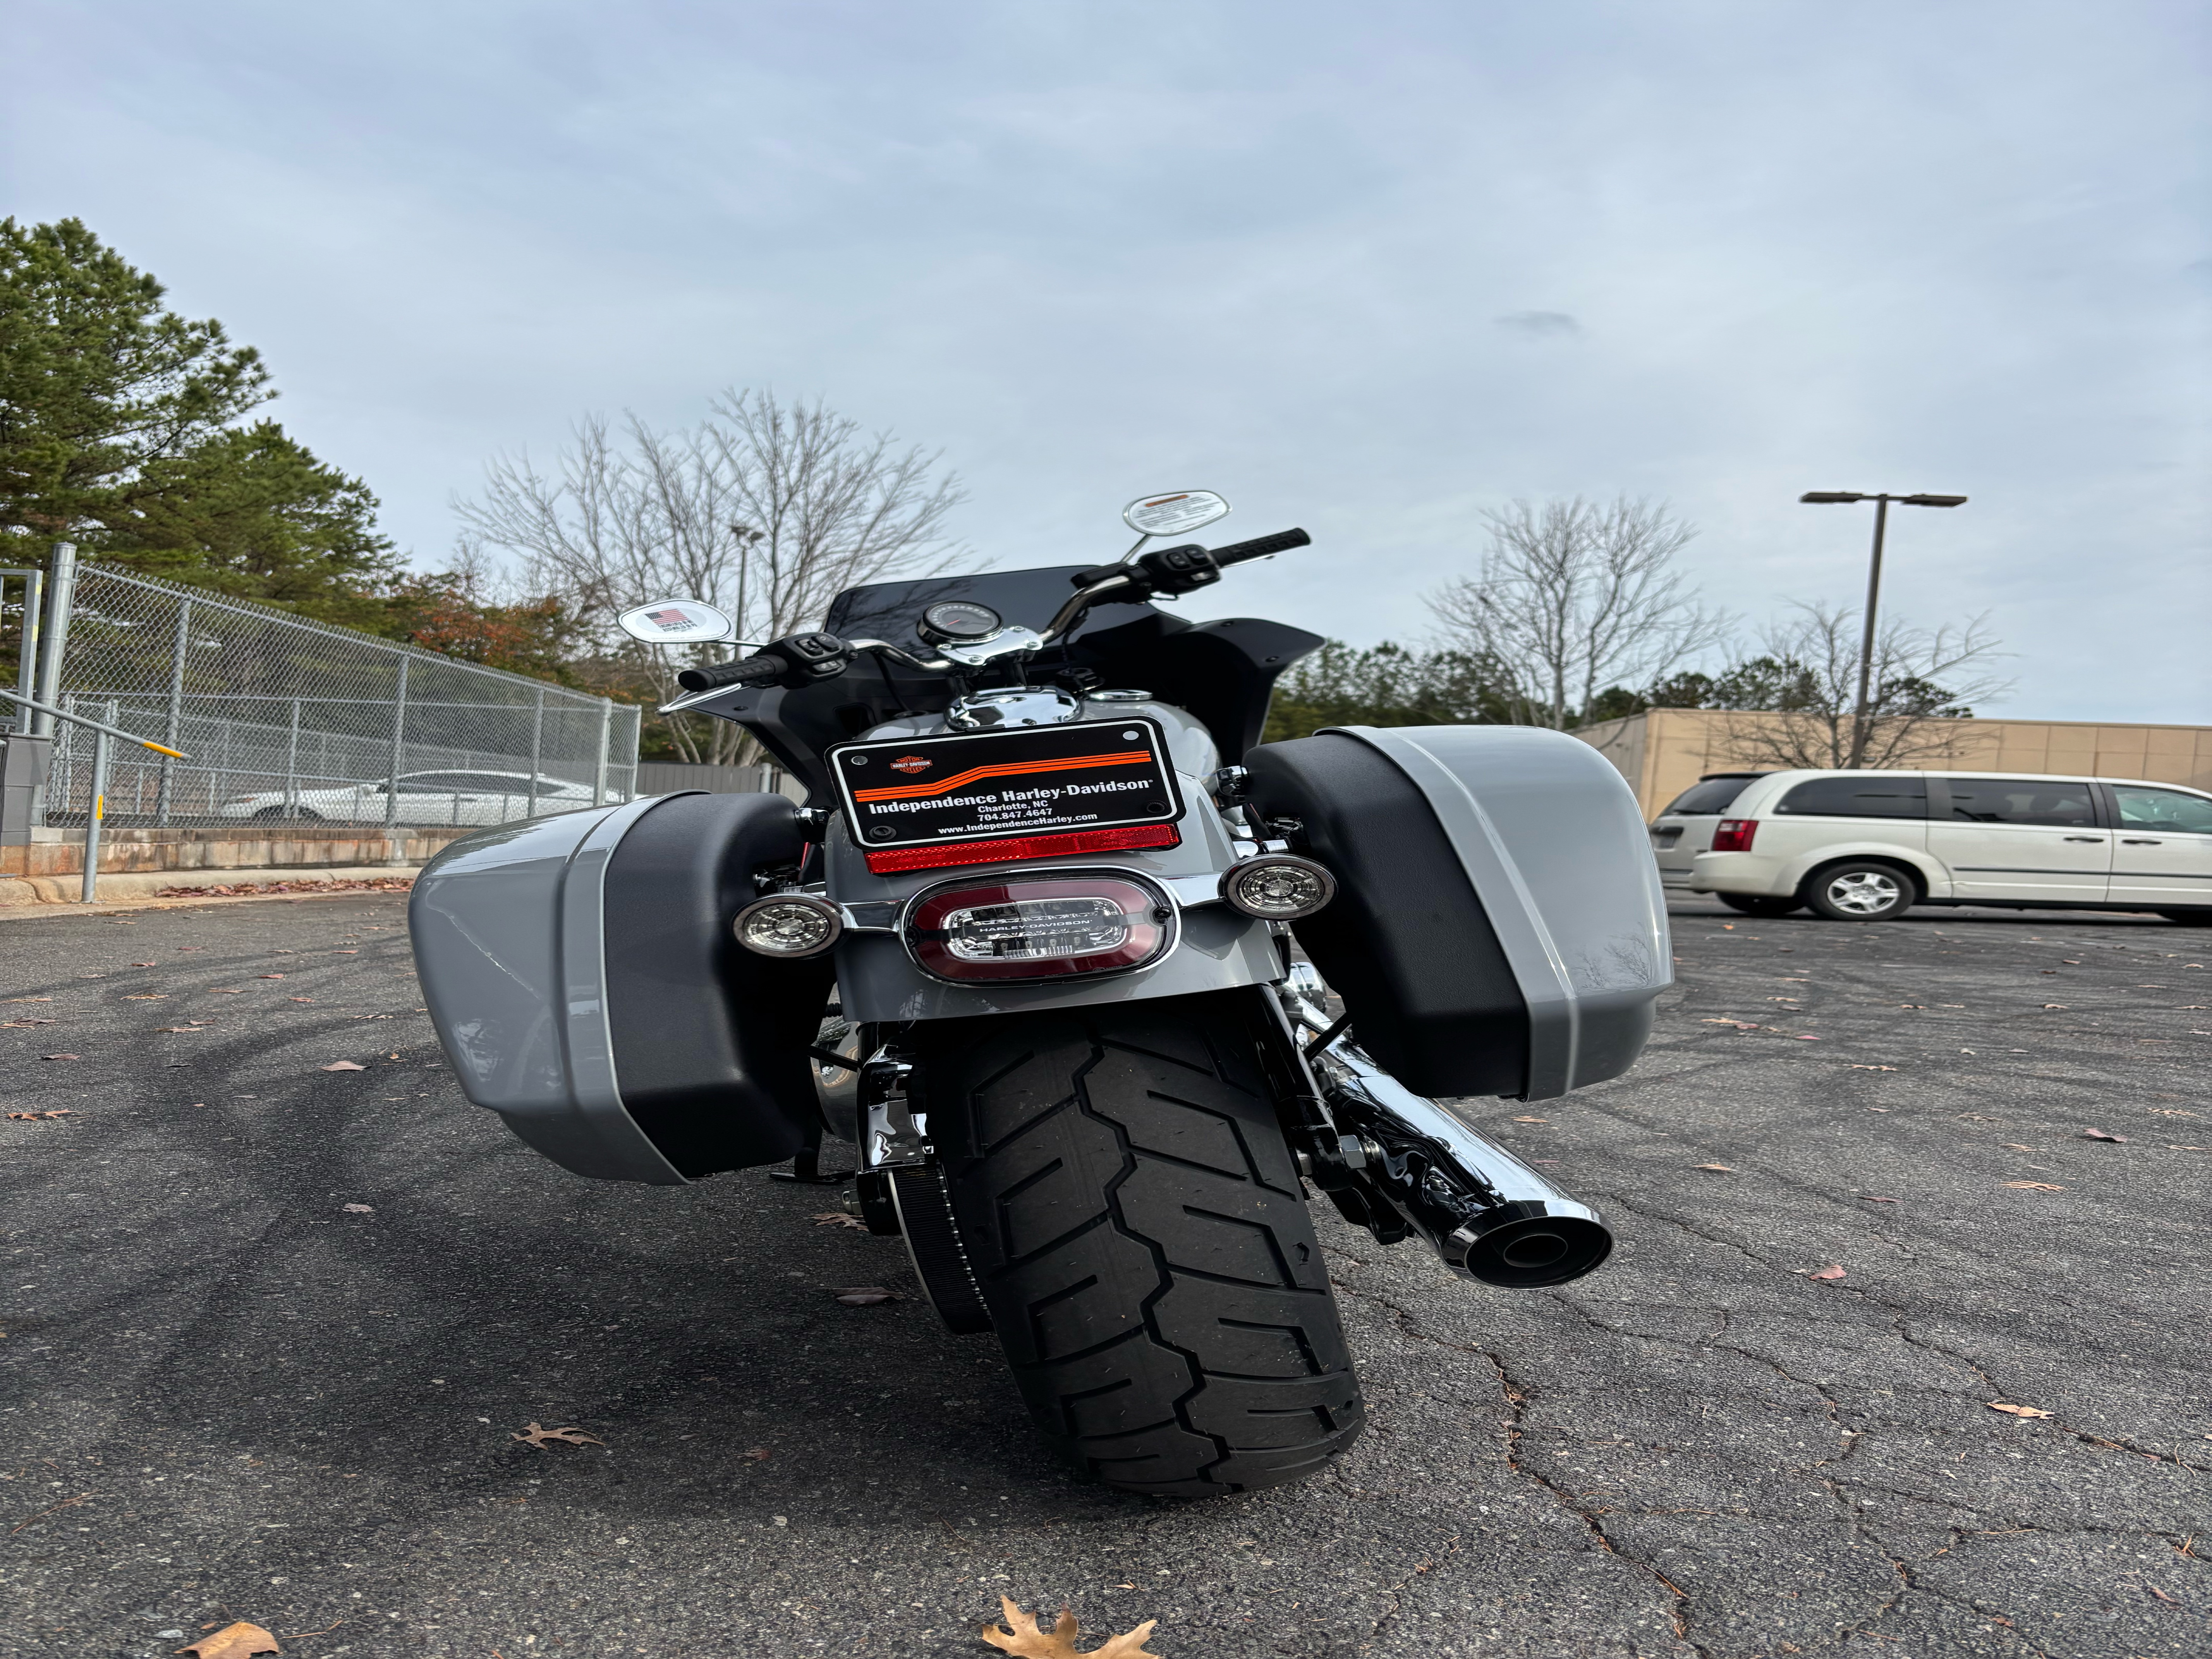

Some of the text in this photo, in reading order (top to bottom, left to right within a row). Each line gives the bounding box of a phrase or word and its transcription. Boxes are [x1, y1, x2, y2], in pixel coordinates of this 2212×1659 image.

[869, 794, 997, 814] Independence
[977, 802, 1031, 813] Charlotte,
[977, 808, 1053, 822] 704.847.4647
[938, 813, 1097, 834] www.IndependenceHarley.com
[979, 920, 1091, 932] HARLEY-DAVIDSON
